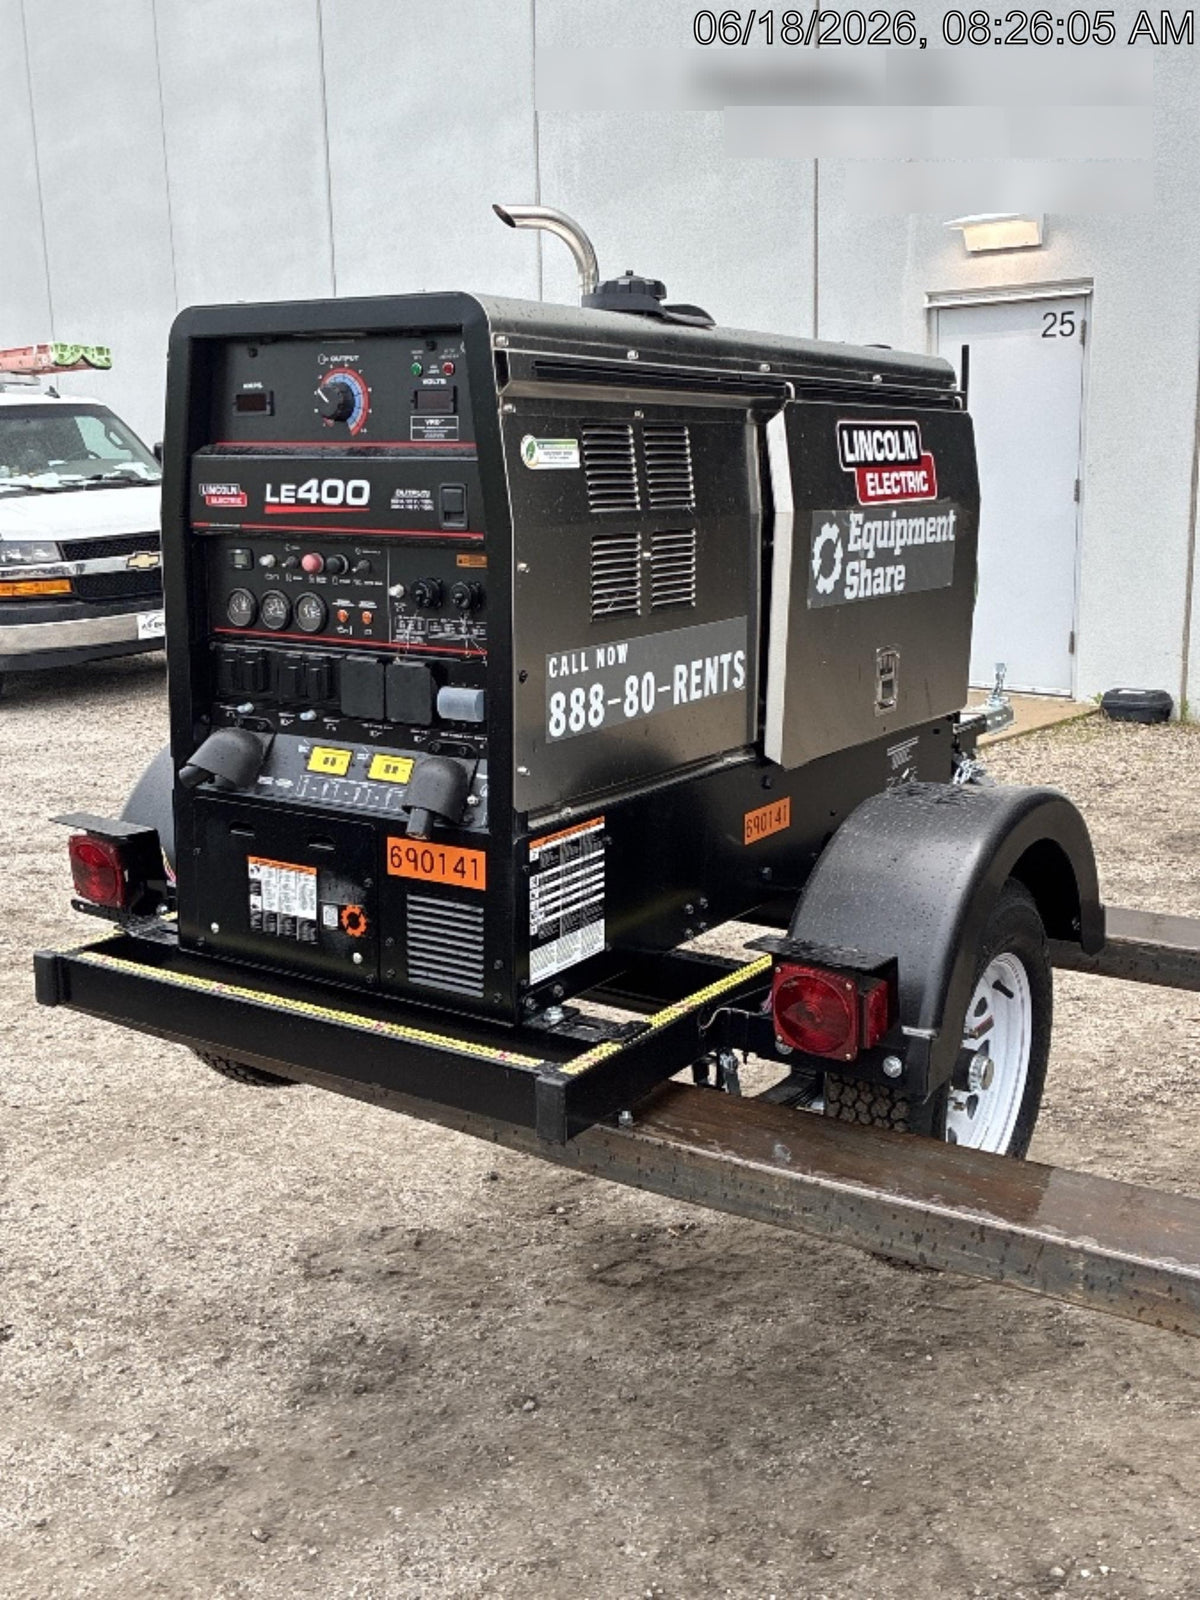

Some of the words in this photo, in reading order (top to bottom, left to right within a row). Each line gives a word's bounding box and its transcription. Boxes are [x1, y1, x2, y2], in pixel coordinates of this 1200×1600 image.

[1042, 310, 1075, 338] 25
[842, 430, 918, 463] LINCOLN
[265, 478, 371, 506] LE400
[865, 470, 929, 496] ELECTRIC
[848, 509, 957, 559] Equipment
[844, 559, 906, 600] Share
[549, 651, 589, 678] CALL
[596, 643, 629, 668] NOW
[549, 650, 746, 738] 888-80-RENTS
[745, 804, 787, 838] 690141
[390, 845, 478, 881] 690141
